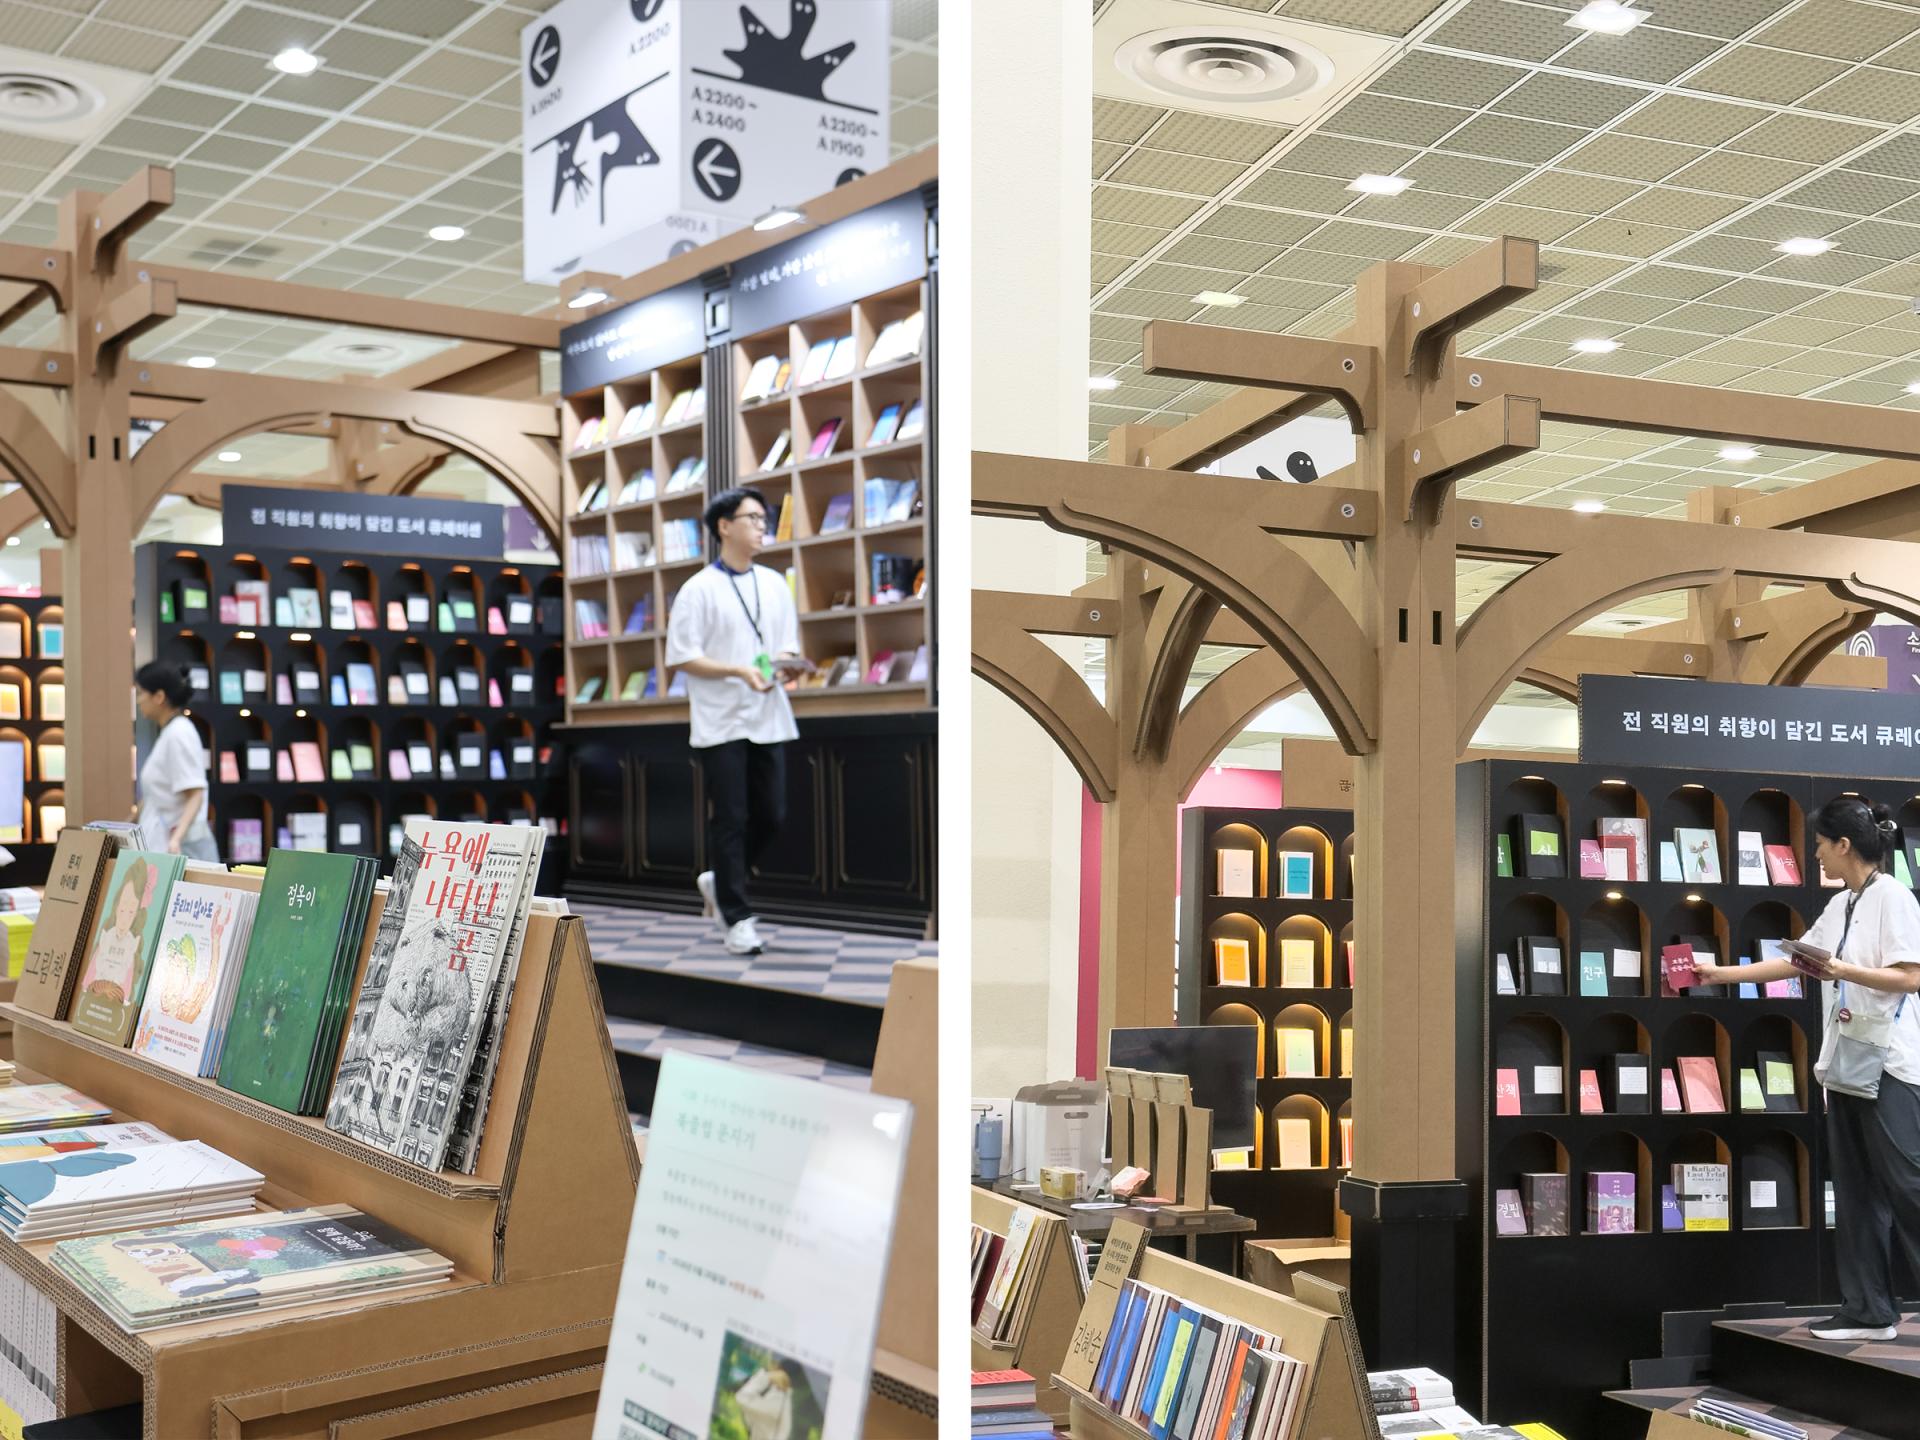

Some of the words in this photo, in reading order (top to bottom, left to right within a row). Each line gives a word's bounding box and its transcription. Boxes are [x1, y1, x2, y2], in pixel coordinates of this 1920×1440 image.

[251, 508, 266, 525] 전
[271, 510, 315, 528] 직원의
[319, 512, 361, 531] 취향이
[365, 515, 394, 533] 담긴
[397, 517, 425, 535] 도서
[1622, 710, 1641, 732] 전
[1650, 712, 1709, 736] 직원의
[1718, 716, 1776, 740] 취향이
[1785, 720, 1822, 742] 담긴
[1830, 723, 1868, 745] 도서
[417, 831, 490, 875] 뉴욕에
[1581, 851, 1601, 864] 수집
[287, 883, 316, 908] 점옥이
[425, 876, 499, 924] 나타난
[448, 928, 476, 972] 곰
[25, 948, 67, 990] 그림책
[1583, 966, 1604, 981] 친구
[1498, 1203, 1521, 1218] 결핍
